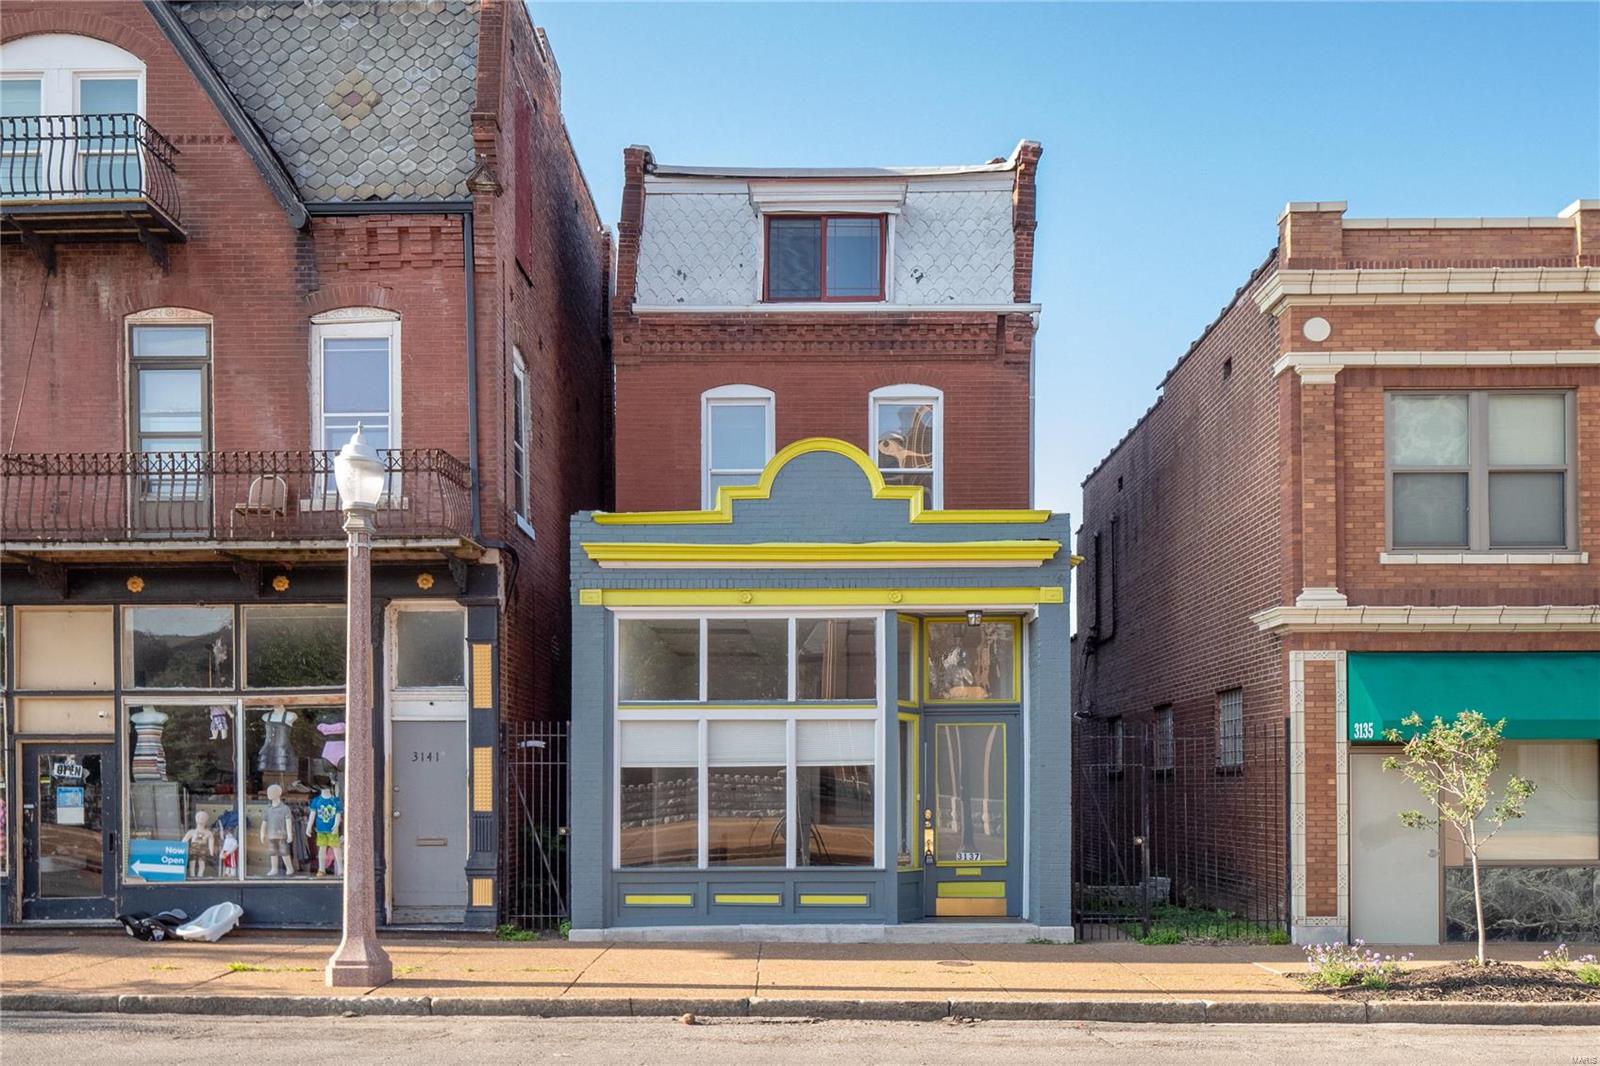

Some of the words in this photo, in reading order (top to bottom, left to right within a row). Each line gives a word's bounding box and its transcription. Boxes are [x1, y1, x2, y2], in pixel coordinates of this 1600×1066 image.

[1353, 722, 1374, 739] 3135
[411, 751, 440, 762] 3141
[165, 846, 186, 854] Now
[161, 855, 185, 865] Open
[956, 852, 981, 861] 3137
